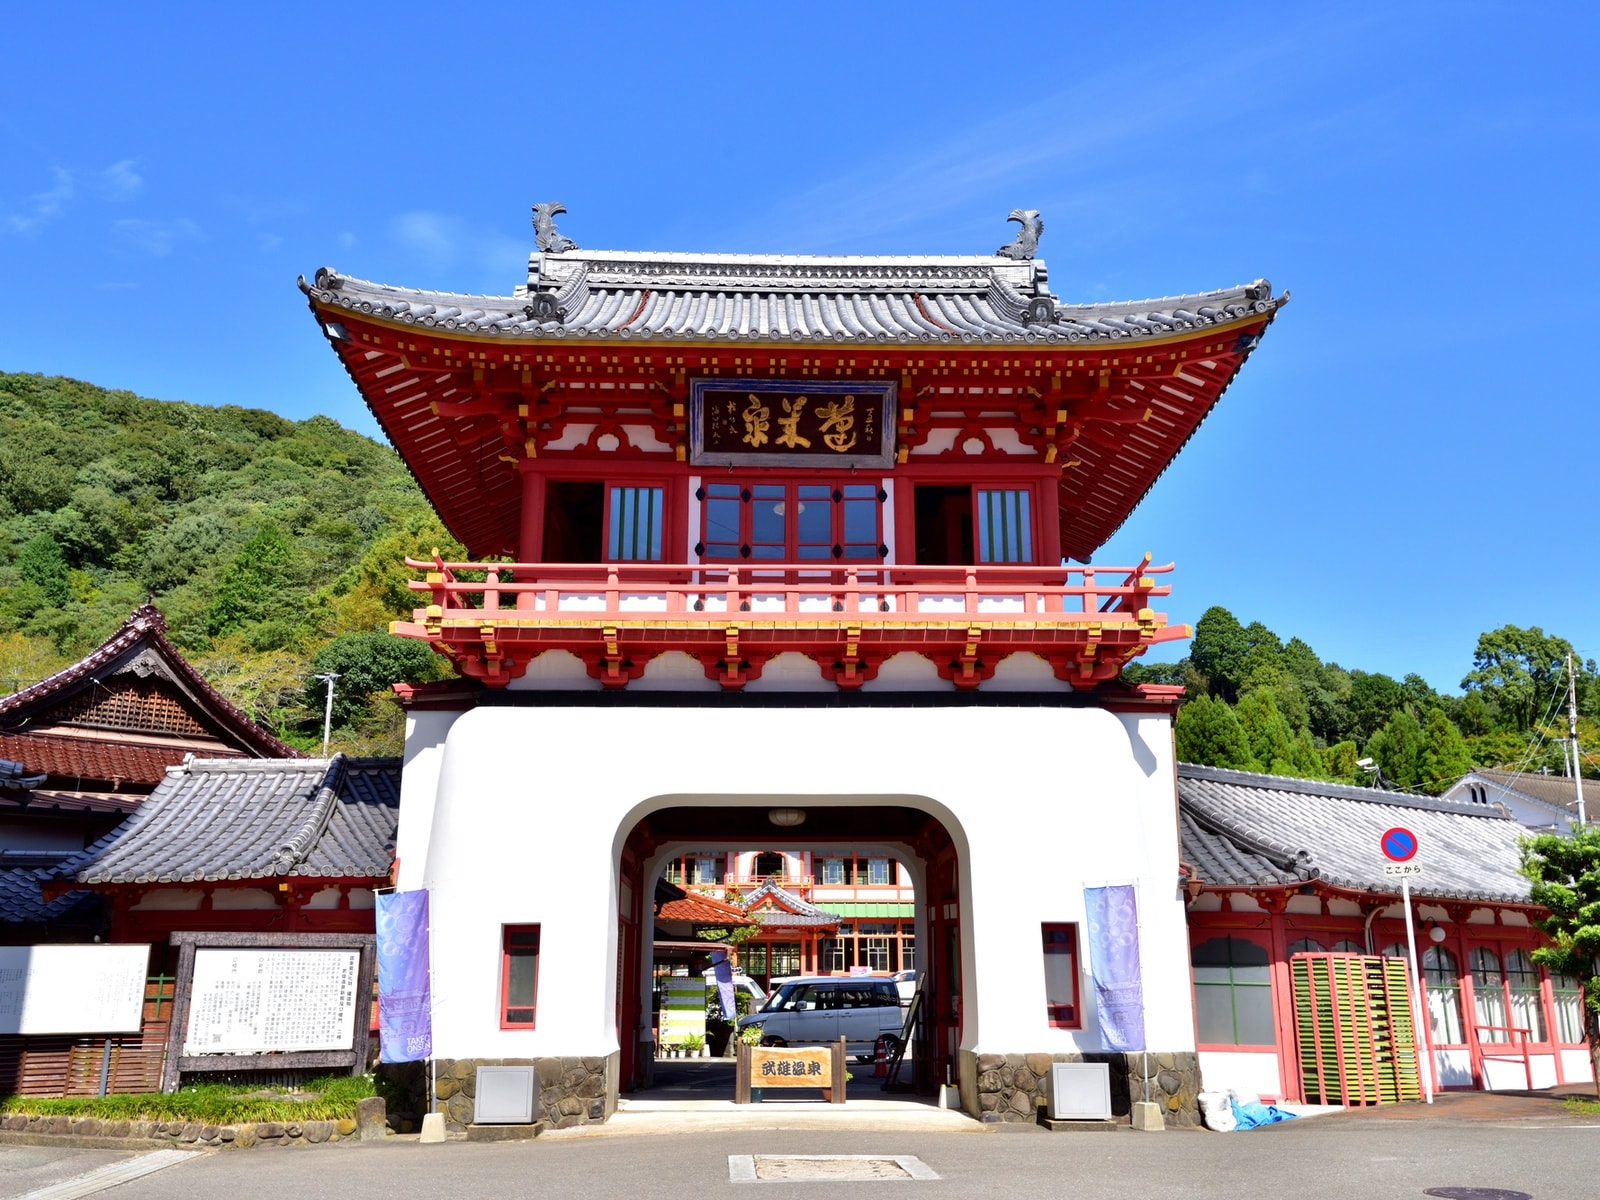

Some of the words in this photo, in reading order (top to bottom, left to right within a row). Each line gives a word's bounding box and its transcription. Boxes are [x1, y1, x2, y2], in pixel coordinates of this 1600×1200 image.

[1385, 864, 1421, 875] ここから
[406, 1034, 430, 1045] TAKEO
[406, 1042, 431, 1052] ONSEN
